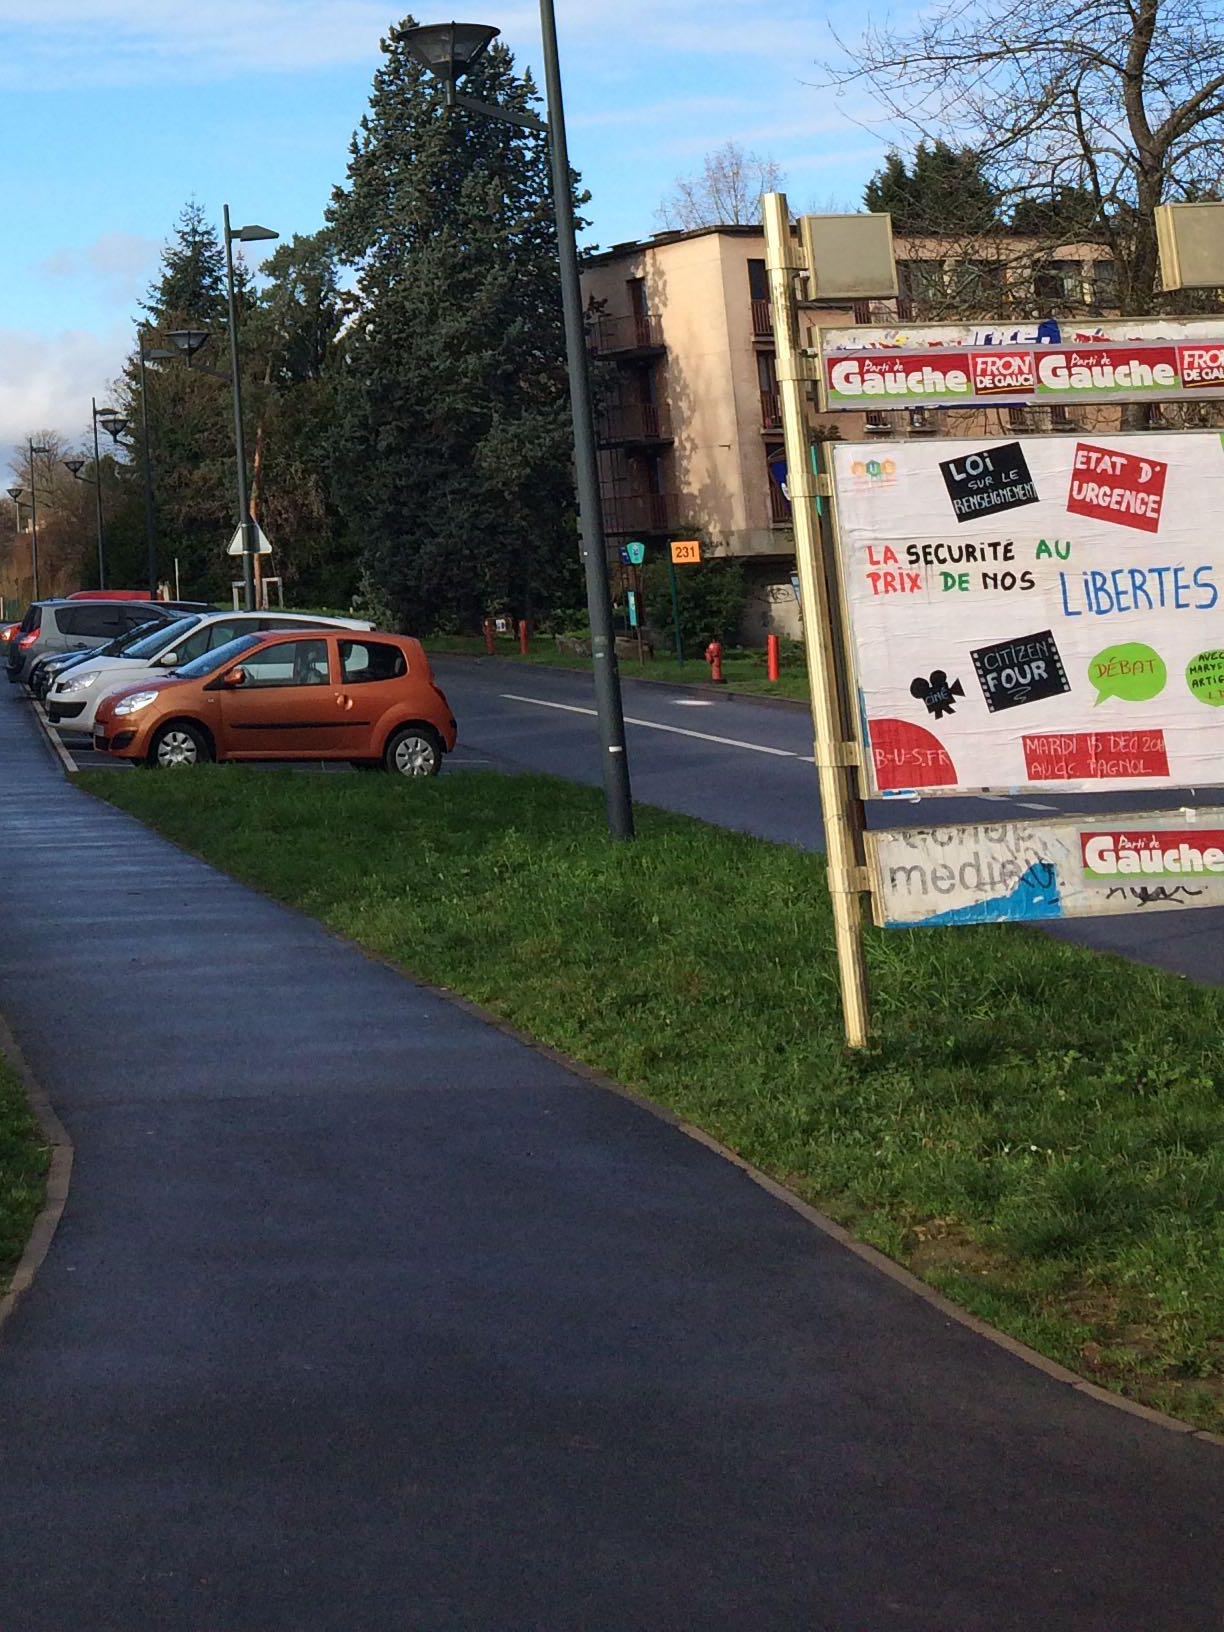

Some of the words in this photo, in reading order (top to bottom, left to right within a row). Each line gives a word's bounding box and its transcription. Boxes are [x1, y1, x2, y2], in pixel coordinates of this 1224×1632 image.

[863, 360, 891, 372] Parti
[976, 356, 1032, 375] FRON
[1070, 354, 1098, 366] Parti
[831, 360, 968, 395] Gauche
[976, 376, 994, 388] DE
[1038, 354, 1175, 389] Gauche
[1183, 369, 1201, 381] DE
[1076, 450, 1128, 476] ETAT
[968, 476, 994, 490] SUR
[1001, 469, 1019, 483] LE
[1073, 480, 1160, 519] URGENCE
[676, 546, 695, 558] 231
[866, 545, 899, 566] LA
[1035, 539, 1071, 560] AU
[939, 571, 970, 592] DE
[982, 570, 1036, 591] NOS
[986, 660, 1049, 692] FOUR
[1095, 656, 1155, 679] DÉBAT
[1026, 736, 1077, 756] MARDI
[1031, 762, 1051, 776] AU
[1118, 834, 1145, 849] Parti
[1084, 835, 1224, 874] Gauche
